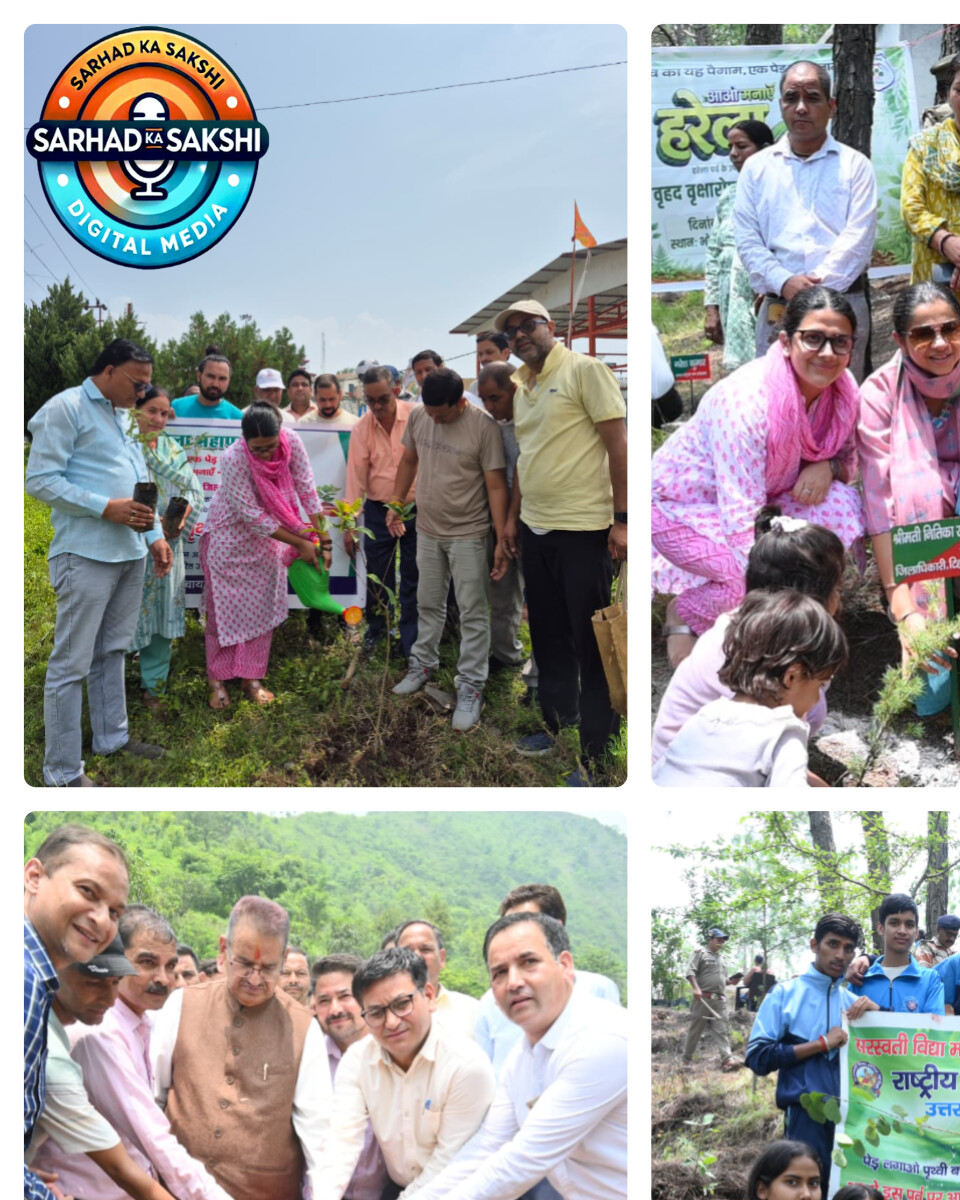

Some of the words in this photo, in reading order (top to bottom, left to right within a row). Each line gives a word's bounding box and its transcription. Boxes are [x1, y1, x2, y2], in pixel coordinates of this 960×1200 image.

[651, 185, 682, 209] वृहद
[685, 177, 738, 206] वृक्षारो
[893, 526, 921, 545] श्रीमती
[923, 523, 954, 541] नितिका
[854, 1032, 909, 1056] सरस्वती
[912, 1033, 947, 1057] विद्या
[891, 1063, 959, 1099] राष्ट्रीय
[863, 1153, 880, 1171] पेड़
[883, 1159, 920, 1175] लगाओ
[923, 1162, 948, 1180] पृथ्वी
